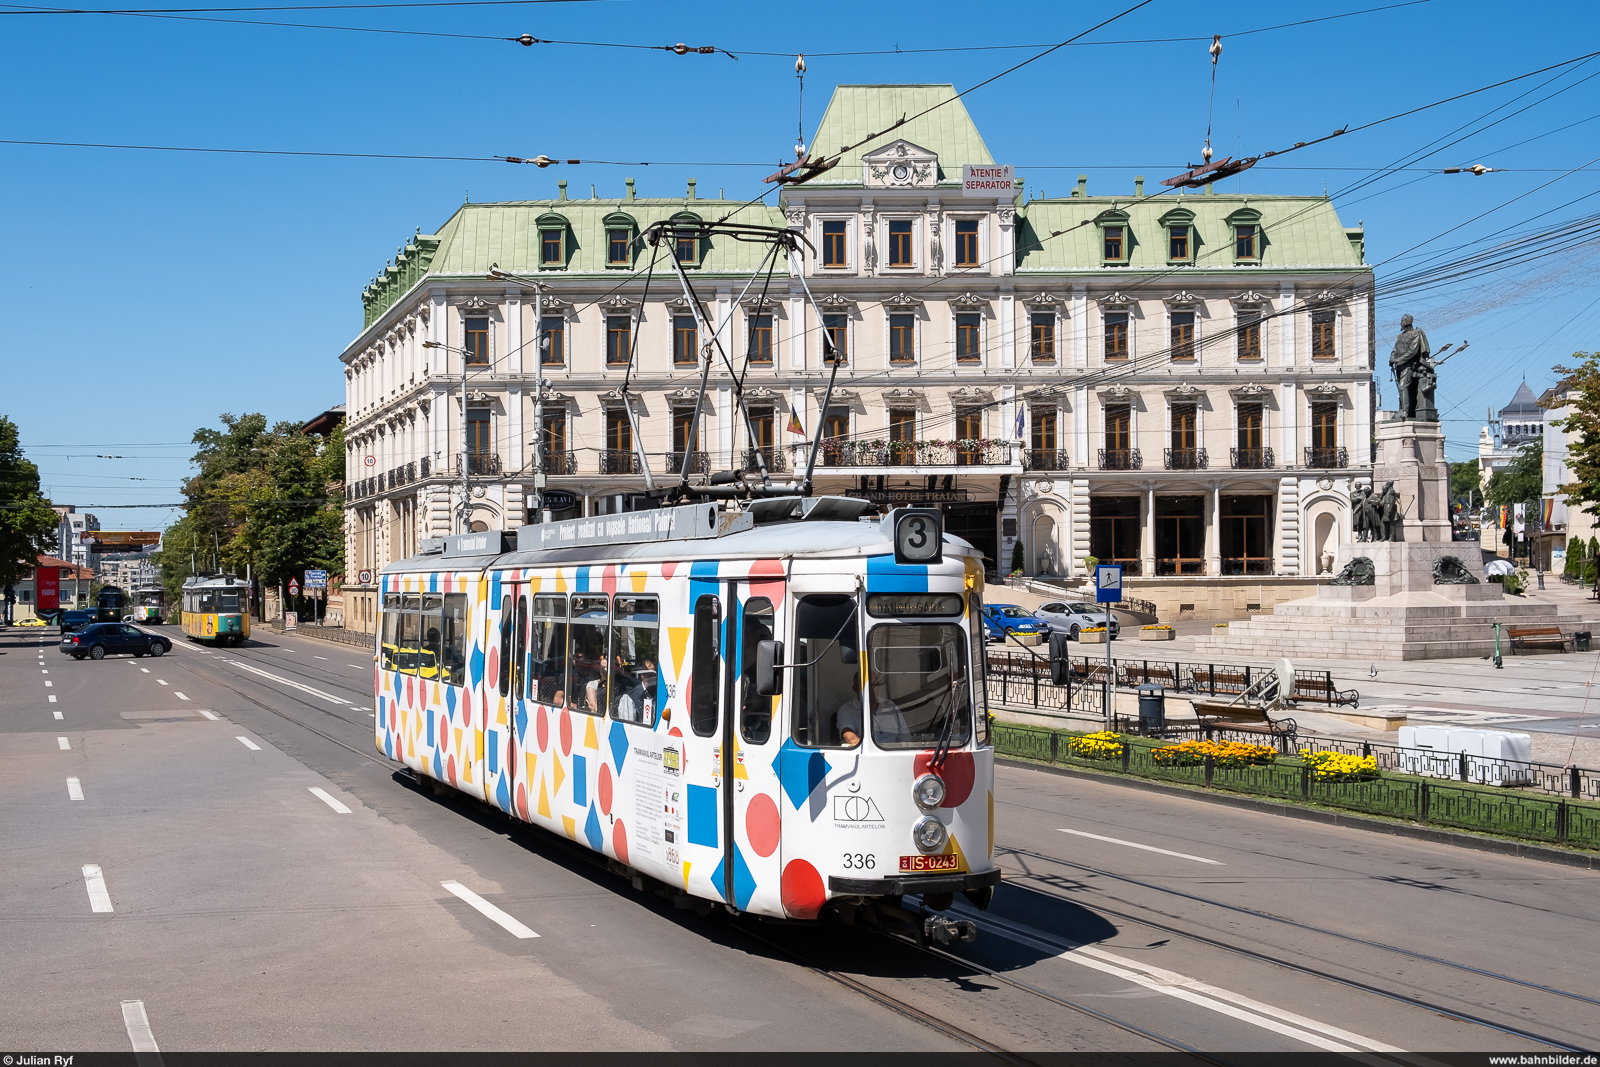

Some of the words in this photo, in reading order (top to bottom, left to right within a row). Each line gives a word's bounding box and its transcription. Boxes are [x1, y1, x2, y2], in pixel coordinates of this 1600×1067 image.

[965, 180, 1011, 190] SEPARATOR
[848, 492, 885, 501] GRAND
[888, 493, 923, 501] HOTEL
[925, 493, 965, 501] TRAIAN
[628, 513, 652, 534] National
[908, 517, 928, 549] 3
[361, 573, 369, 581] 10
[664, 683, 677, 699] 336
[843, 853, 876, 869] 336
[912, 855, 956, 870] IS-0243
